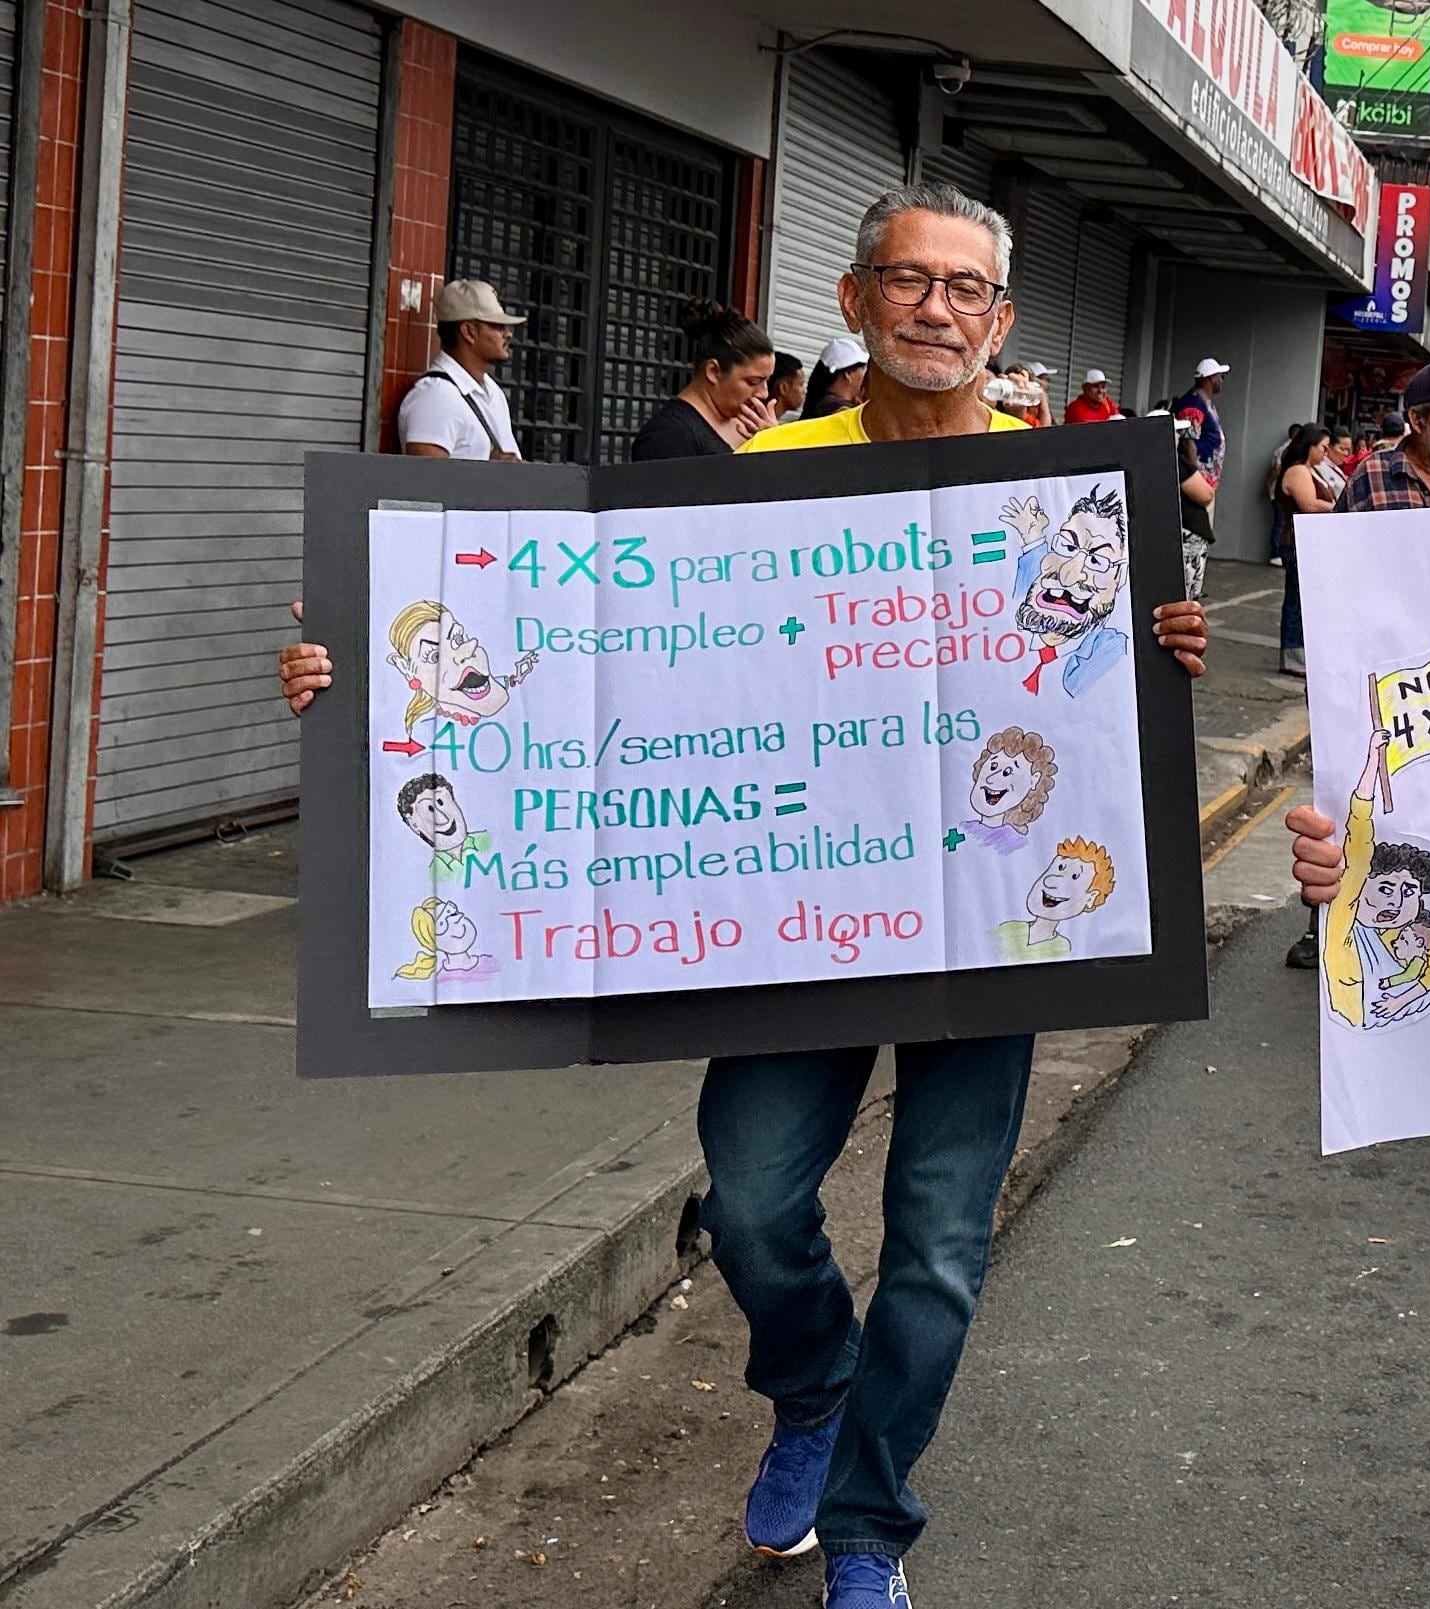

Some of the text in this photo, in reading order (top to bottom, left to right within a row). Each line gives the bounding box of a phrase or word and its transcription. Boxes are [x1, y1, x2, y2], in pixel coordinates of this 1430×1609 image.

[1341, 37, 1391, 53] Comprar
[1391, 192, 1416, 323] PROMOS
[670, 550, 778, 608] para
[790, 522, 953, 577] robots
[515, 612, 764, 666] Desempleo
[814, 583, 1005, 630] Trabajo
[825, 626, 1026, 680] precario
[429, 721, 512, 772] 40
[812, 715, 905, 767] para
[923, 701, 981, 746] las
[514, 784, 762, 832] PERSONAS
[464, 843, 569, 891] Más
[586, 824, 915, 895] empleabilidad
[500, 903, 924, 966] Trabajo digno
